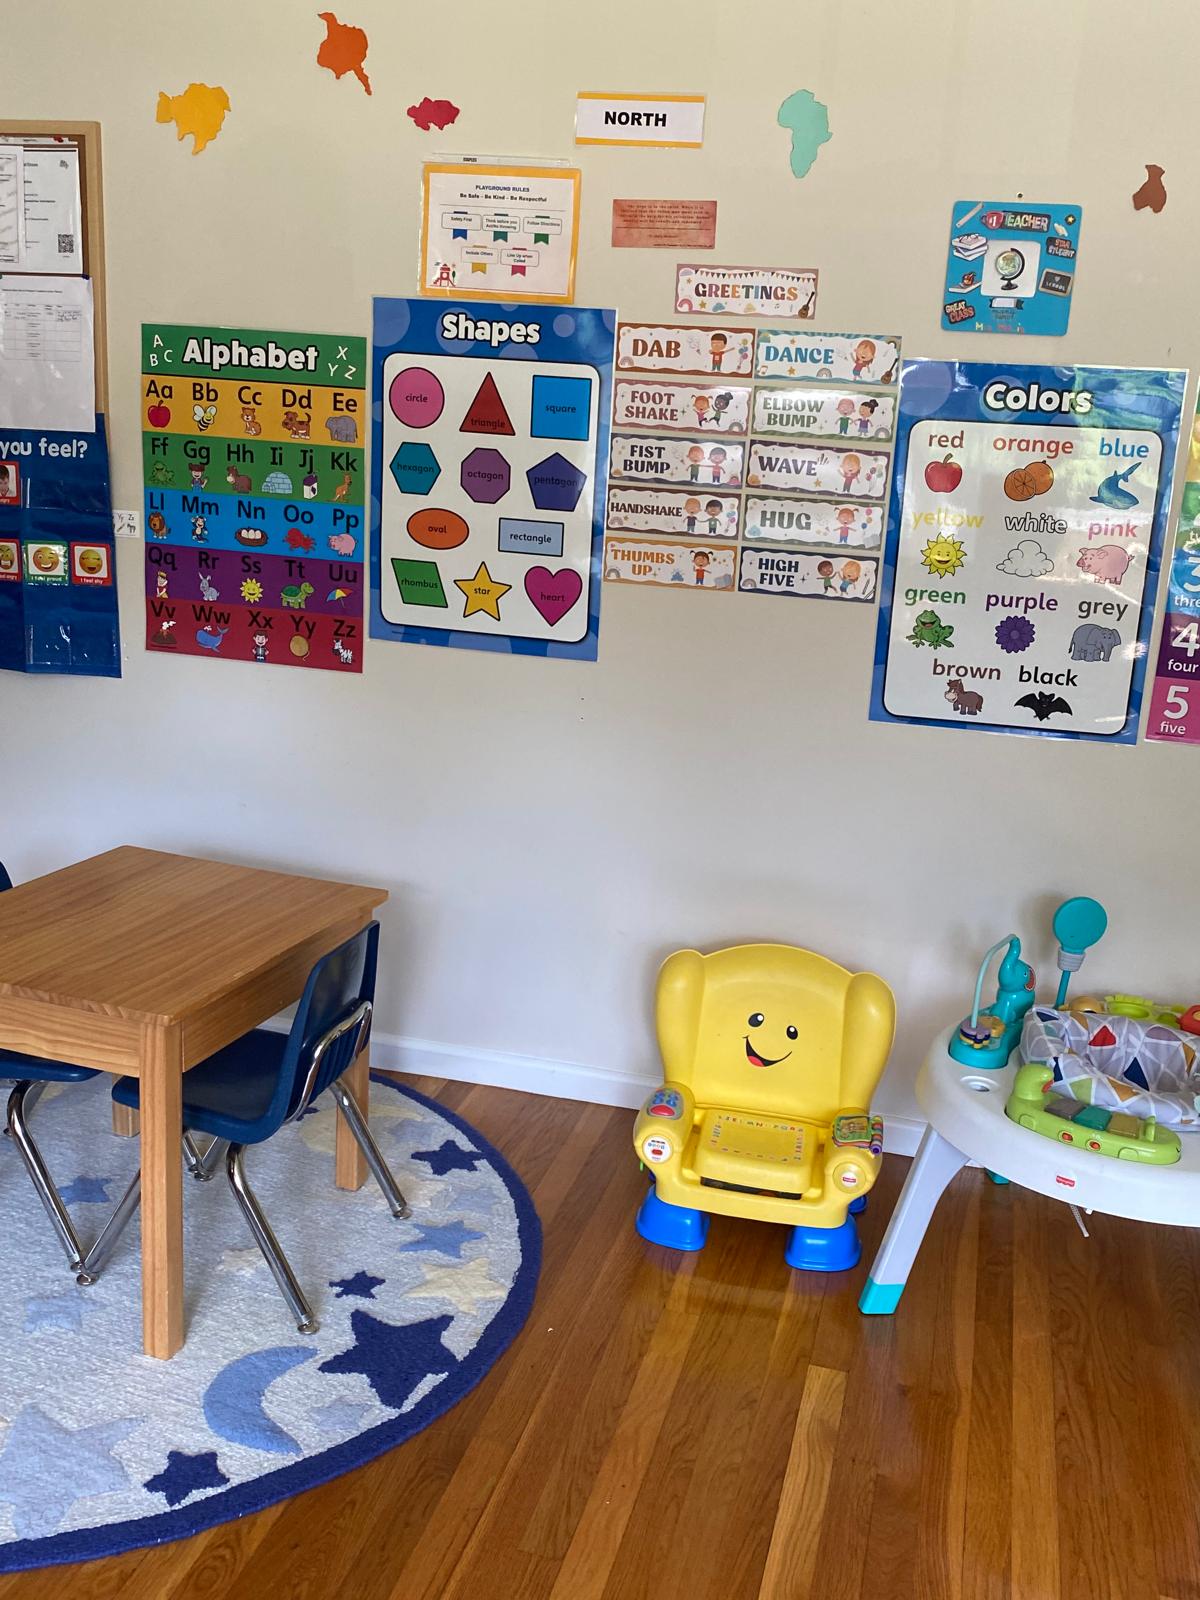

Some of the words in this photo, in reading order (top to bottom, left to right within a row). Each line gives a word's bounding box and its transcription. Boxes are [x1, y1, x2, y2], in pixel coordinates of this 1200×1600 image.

[604, 111, 667, 127] NORTH
[1005, 213, 1048, 231] TEACHER
[694, 282, 798, 301] GREETINGS
[442, 313, 541, 347] Shapes
[153, 335, 163, 348] A
[632, 338, 681, 359] DAB
[150, 354, 158, 367] B
[164, 350, 173, 363] C
[183, 337, 318, 371] Alphabet
[336, 346, 348, 360] X
[765, 346, 834, 365] DANCE
[327, 364, 339, 377] Y
[345, 366, 357, 380] Z
[146, 380, 173, 399] Aa
[193, 383, 218, 401] Bb
[238, 386, 262, 405] Cc
[282, 390, 312, 409] Dd
[333, 393, 358, 412] Ee
[405, 394, 428, 403] circle
[631, 391, 675, 406] FOOT
[983, 381, 1094, 414] Colors
[545, 404, 576, 414] square
[762, 397, 824, 413] ELBOW
[625, 406, 679, 422] SHAKE
[767, 412, 817, 428] BUMP
[471, 418, 505, 429] triangle
[929, 431, 965, 448] red
[993, 437, 1074, 459] orange
[1100, 437, 1150, 458] blue
[0, 440, 32, 459] you
[39, 438, 88, 458] feel?
[152, 438, 168, 456] Ff
[183, 441, 210, 465] Gg
[227, 444, 254, 463] Hh
[270, 447, 283, 466] Ii
[299, 450, 314, 474] Jj
[331, 453, 357, 472] Kk
[629, 445, 666, 459] FIST
[397, 463, 434, 474] hexagon
[622, 459, 670, 474] BUMP
[758, 456, 817, 476] WAVE
[467, 470, 504, 481] octagon
[534, 476, 577, 487] pentagon
[182, 496, 219, 516] Mm
[238, 501, 265, 520] Nn
[284, 505, 314, 525] Oo
[333, 510, 359, 532] Pp
[610, 502, 683, 517] HANDSHAKE
[760, 511, 811, 530] HUG
[912, 507, 984, 530] yellow
[1004, 512, 1068, 534] white
[428, 525, 447, 534] oval
[1088, 518, 1138, 540] pink
[510, 532, 552, 544] rectangle
[148, 547, 176, 571] Qq
[199, 552, 220, 569] Rr
[242, 556, 261, 574] Ss
[285, 560, 305, 578] Tt
[329, 564, 357, 583] Uu
[611, 548, 675, 565] THUMBS
[758, 557, 799, 572] HIGH
[632, 564, 652, 576] UP
[401, 578, 438, 589] rhombus
[760, 572, 795, 587] FIVE
[474, 587, 490, 595] star
[541, 592, 565, 601] heart
[904, 588, 966, 606] green
[985, 592, 1058, 614] purple
[1078, 600, 1128, 621] grey
[151, 601, 176, 618] Vv
[192, 605, 231, 624] Ww
[248, 610, 273, 629] Xx
[290, 615, 316, 638] Yy
[334, 619, 355, 638] Zz
[1172, 622, 1200, 657] 4
[933, 659, 1001, 680] brown
[1168, 659, 1199, 673] four
[1019, 665, 1078, 687] black
[1163, 685, 1190, 719] 5
[1160, 721, 1186, 734] five
